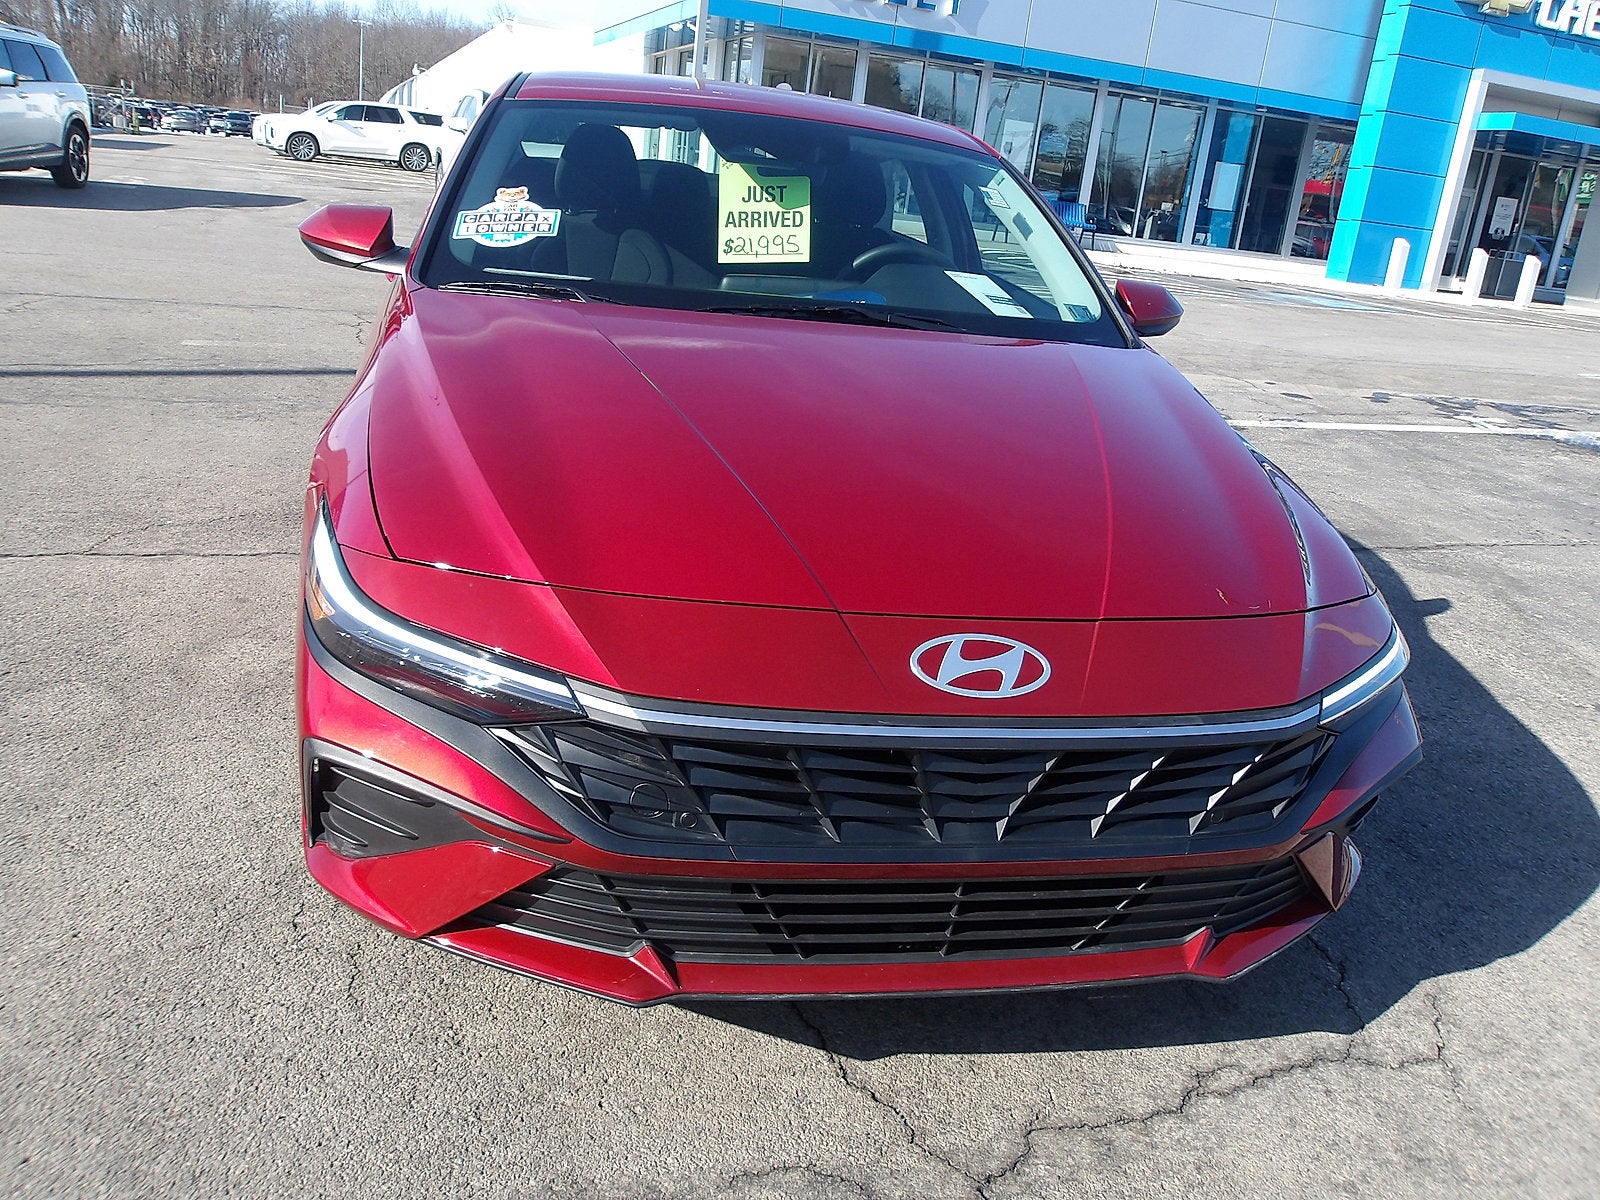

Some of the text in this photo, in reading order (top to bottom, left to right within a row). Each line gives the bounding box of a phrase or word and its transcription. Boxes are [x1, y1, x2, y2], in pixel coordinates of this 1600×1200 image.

[741, 185, 787, 203] JUST
[463, 212, 550, 224] CARFAX
[724, 210, 804, 228] ARRIVED
[475, 223, 552, 234] OWNER
[723, 234, 800, 259] $21,995
